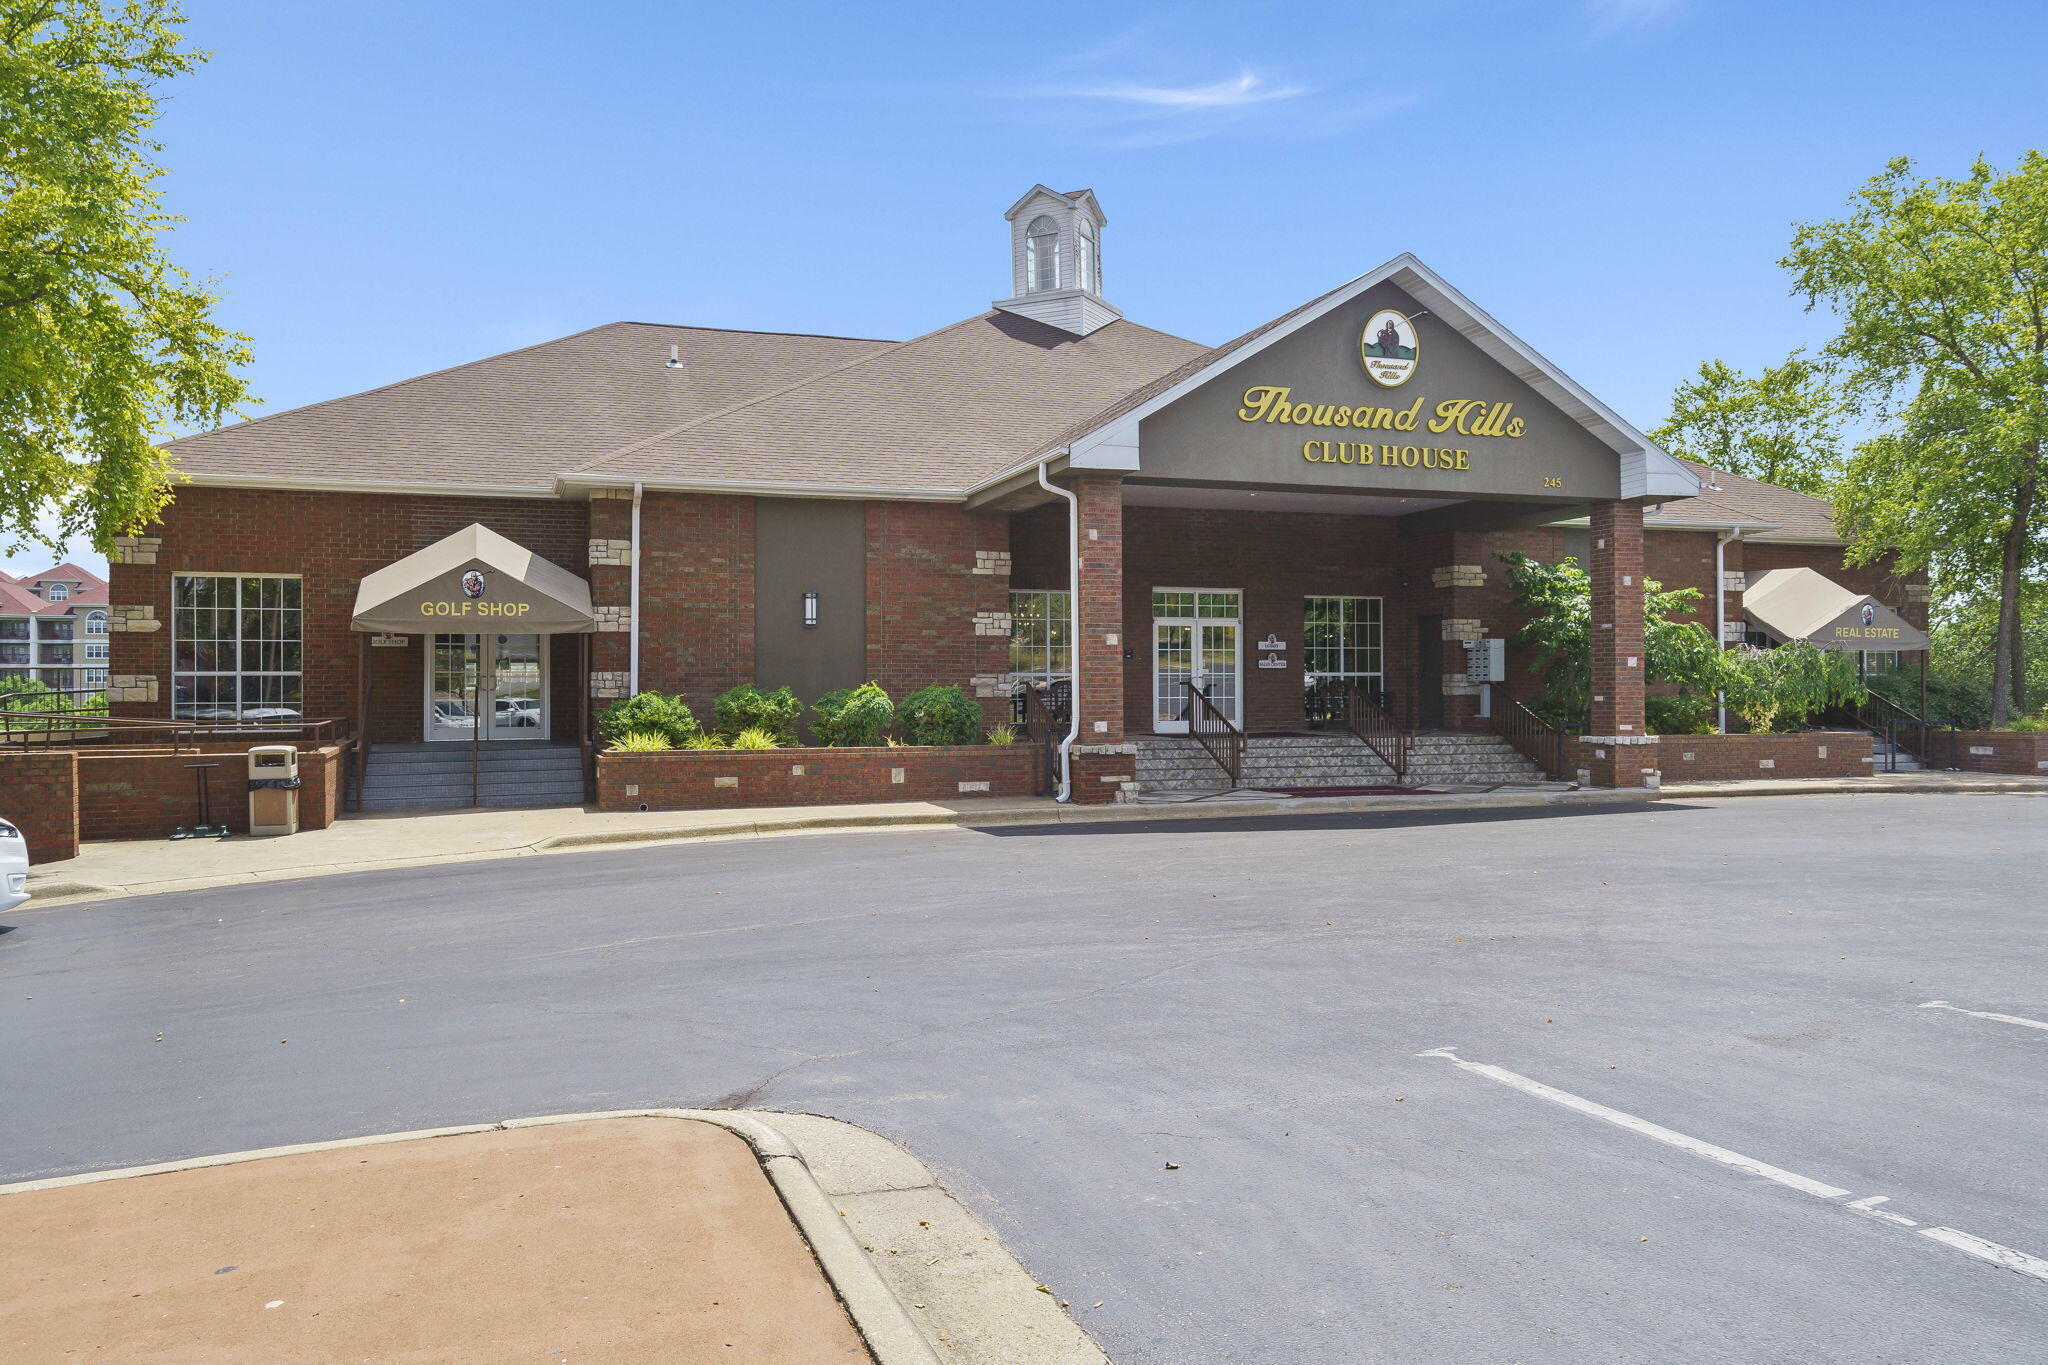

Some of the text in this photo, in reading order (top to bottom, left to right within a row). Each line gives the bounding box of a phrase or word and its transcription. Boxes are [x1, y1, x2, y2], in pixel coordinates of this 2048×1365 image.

[1369, 360, 1409, 371] Thousand
[1379, 370, 1401, 380] Hills
[1238, 385, 1527, 438] Thousand Hills
[1303, 440, 1471, 470] CLUB HOUSE
[1543, 476, 1562, 489] 245
[420, 601, 530, 617] GOLF SHOP
[1835, 626, 1900, 639] REAL ESTATE
